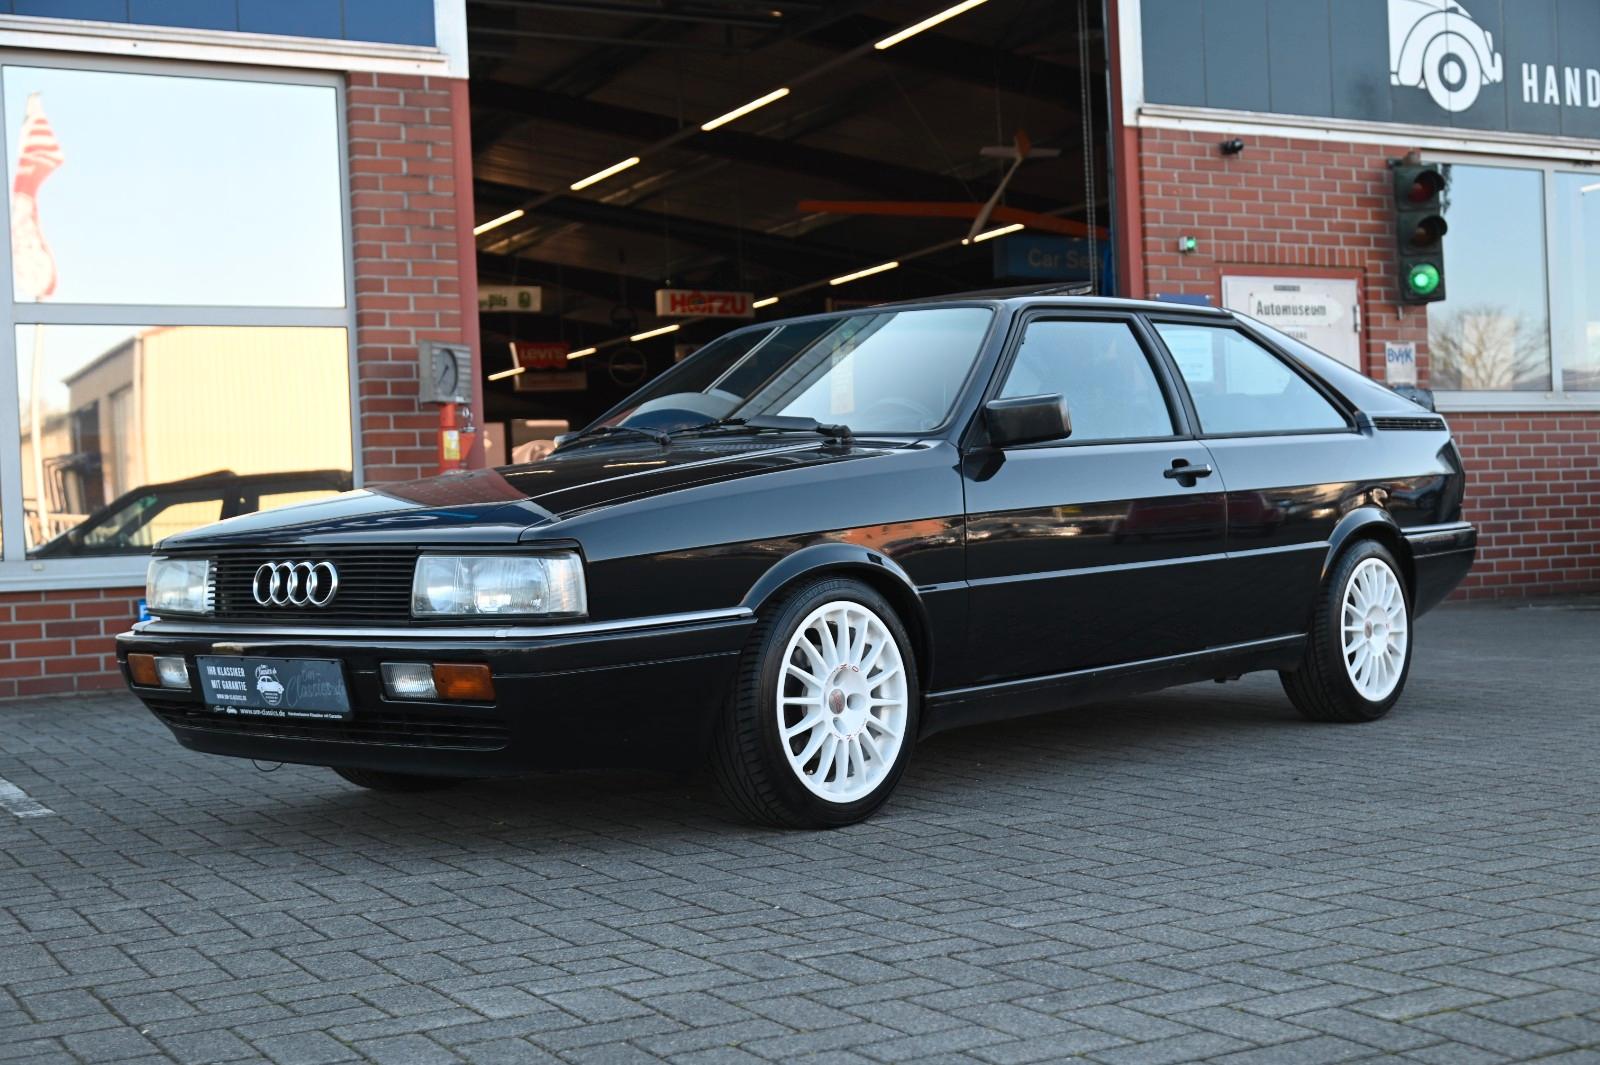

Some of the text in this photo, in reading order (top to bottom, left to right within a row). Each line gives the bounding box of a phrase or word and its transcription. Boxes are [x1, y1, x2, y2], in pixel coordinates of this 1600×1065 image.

[1522, 63, 1600, 108] HAND
[1027, 248, 1059, 268] Car
[1256, 301, 1326, 317] Automuseum
[206, 665, 245, 677] IHR KLASSIKER
[210, 679, 221, 689] MIT
